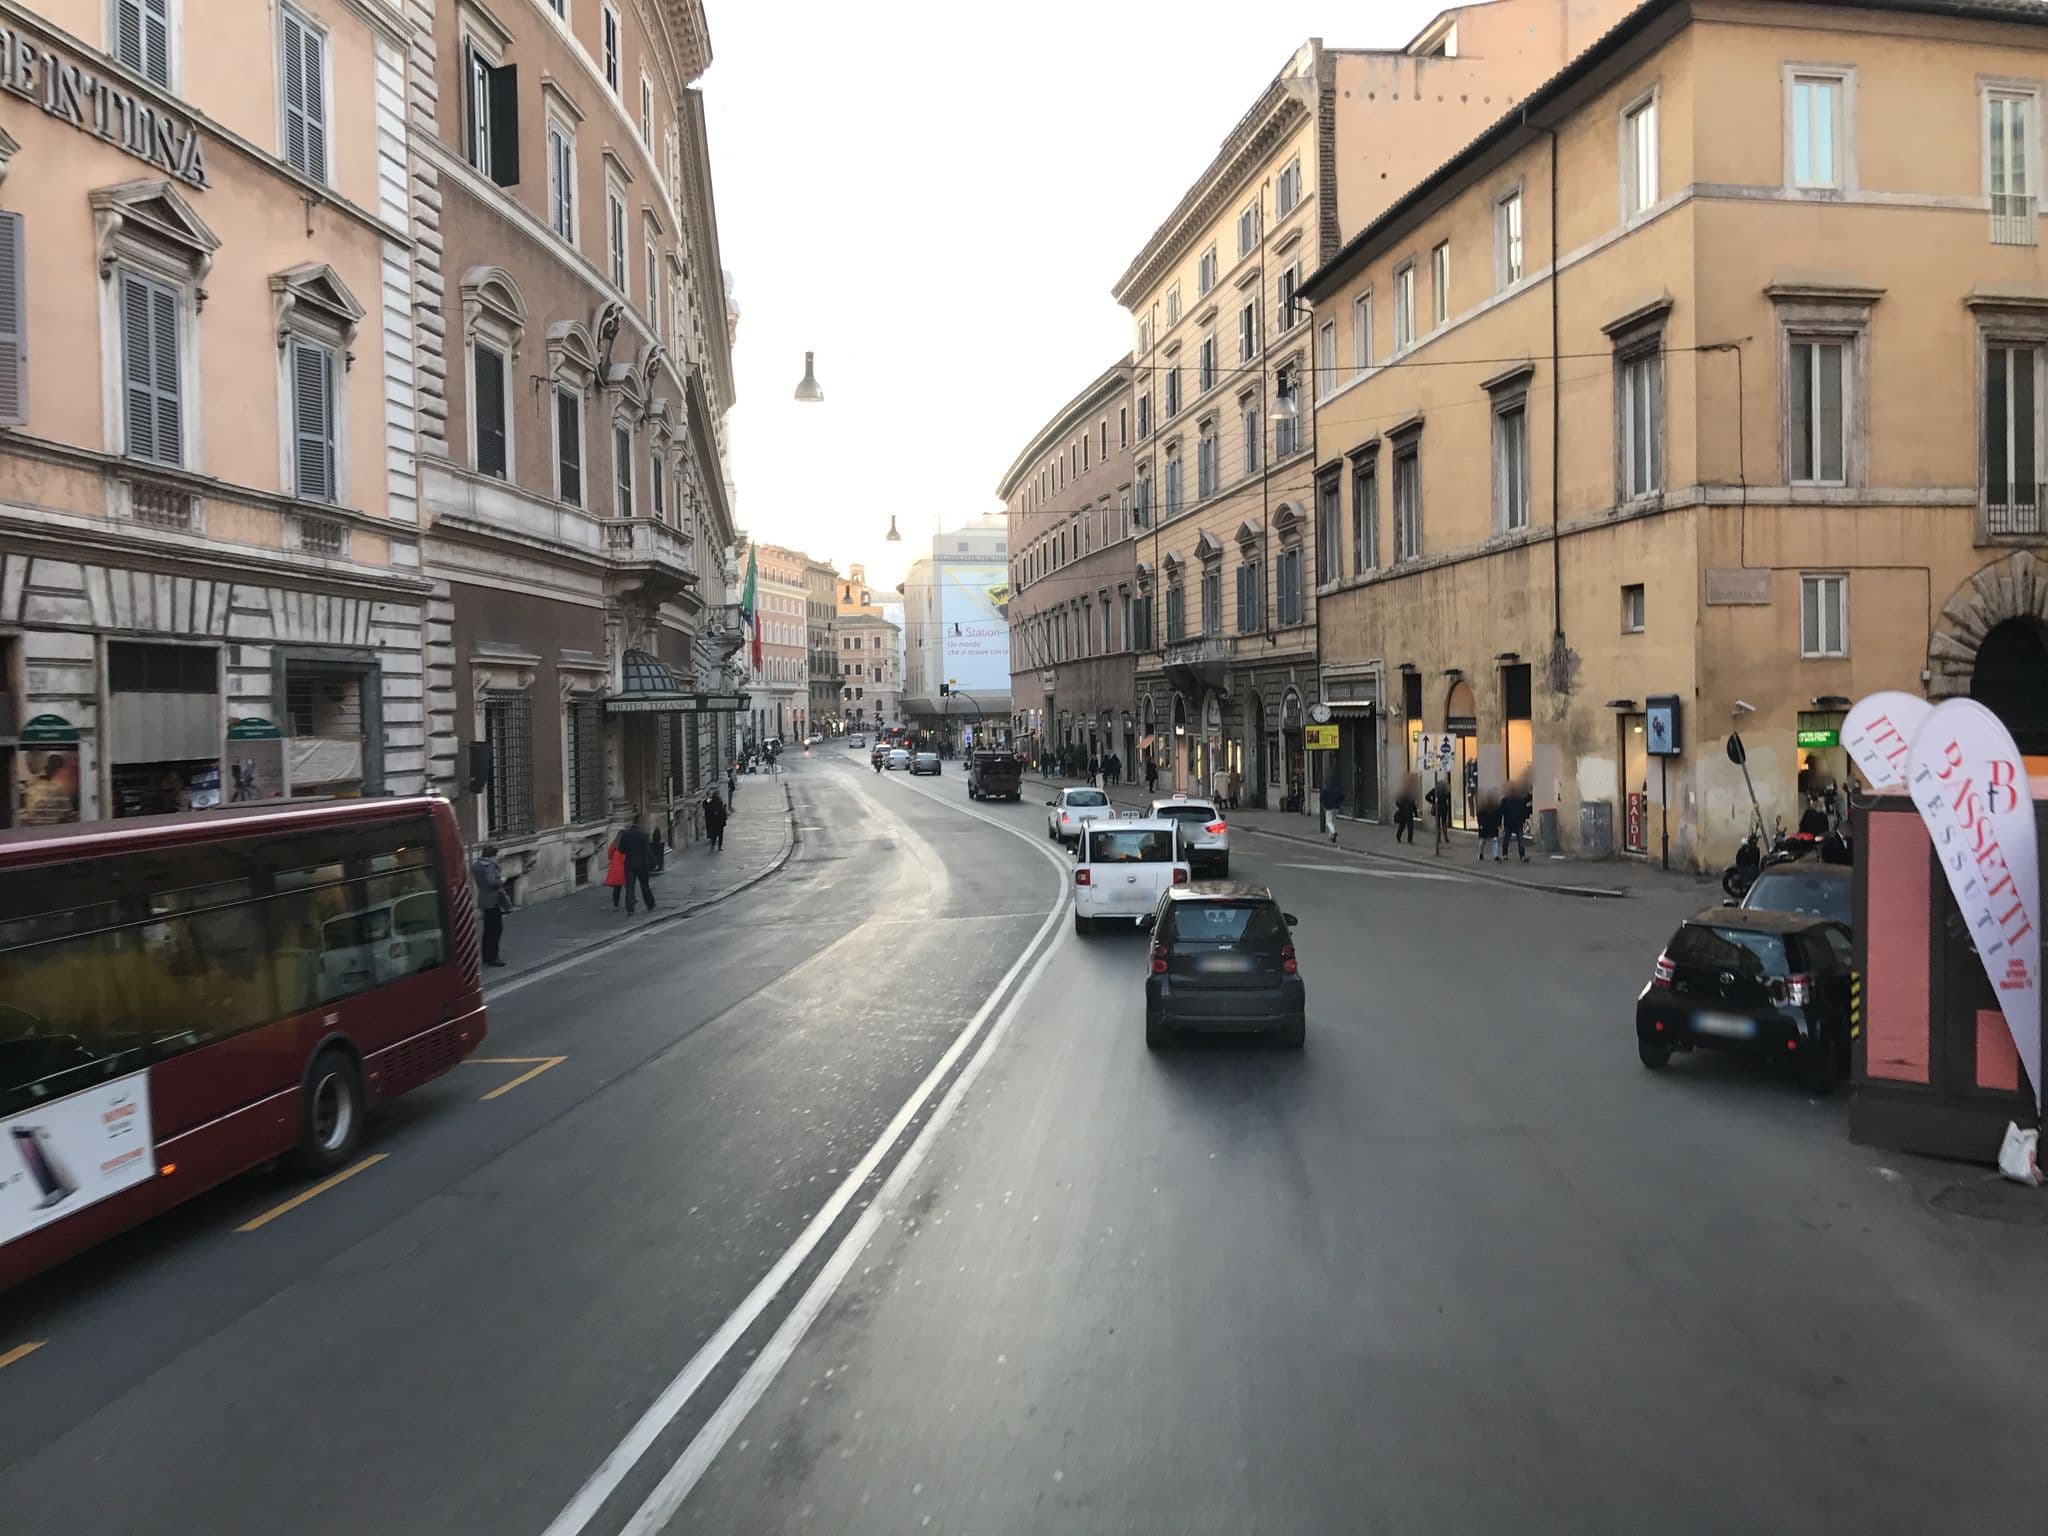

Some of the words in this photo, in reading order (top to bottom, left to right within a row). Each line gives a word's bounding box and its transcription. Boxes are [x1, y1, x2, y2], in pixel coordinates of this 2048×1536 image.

[966, 627, 1000, 637] Station
[612, 703, 645, 711] HOTEL
[1630, 795, 1639, 845] SALDI
[1937, 738, 2032, 946] BASSETTI
[1914, 763, 2003, 955] TESSUTI
